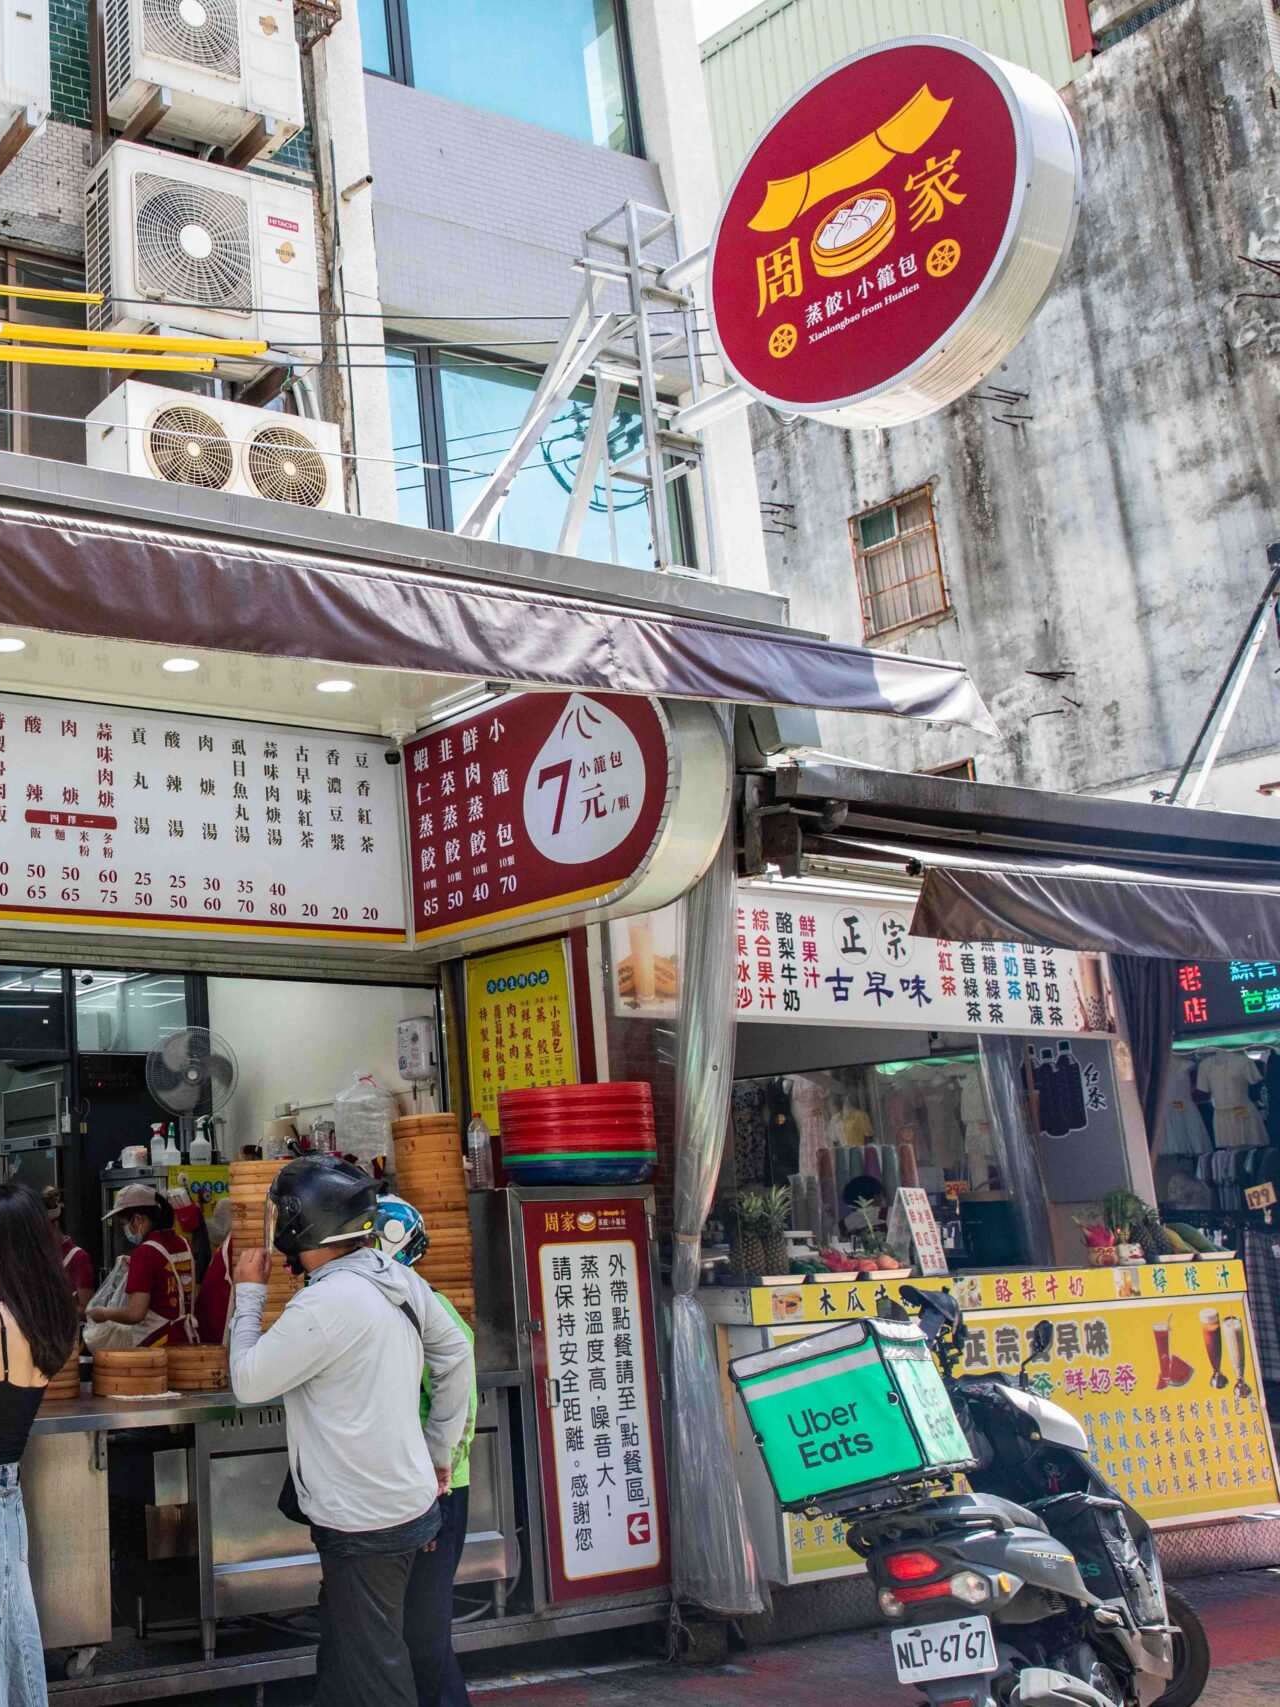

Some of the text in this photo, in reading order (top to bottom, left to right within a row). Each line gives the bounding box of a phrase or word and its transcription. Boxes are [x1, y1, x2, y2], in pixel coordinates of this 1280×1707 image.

[808, 282, 920, 345] Xiaolongbao from Hualien
[24, 715, 43, 802] 酸辣
[578, 751, 623, 780] 小籠包
[131, 727, 150, 835] 貢丸湯
[164, 731, 184, 838] 酸辣湯
[231, 738, 250, 844] 虱目魚丸湯
[462, 725, 486, 857] 鮮肉蒸餃
[488, 718, 514, 848] 小籠包
[295, 745, 314, 849] 古早味紅茶
[325, 749, 345, 851] 香濃豆漿
[354, 752, 374, 853] 豆香紅茶
[413, 747, 436, 872] 蝦仁蒸餃
[438, 738, 461, 865] 韭菜蒸餃
[537, 759, 572, 836] 7
[30, 827, 41, 839] 飯
[78, 831, 90, 857] 米粉
[103, 832, 114, 859] 冬粉
[27, 864, 46, 878] 50
[61, 867, 80, 881] 50
[99, 870, 117, 884] 60
[134, 872, 151, 886] 25
[169, 875, 186, 889] 25
[27, 886, 46, 899] 65
[61, 888, 80, 902] 65
[100, 890, 118, 904] 75
[203, 878, 220, 891] 30
[237, 880, 253, 894] 35
[269, 883, 286, 896] 40
[472, 882, 489, 902] 40
[499, 875, 517, 894] 70
[134, 892, 152, 906] 50
[170, 895, 187, 909] 50
[204, 897, 221, 911] 60
[238, 899, 254, 913] 70
[270, 903, 287, 916] 80
[302, 903, 318, 917] 20
[423, 897, 439, 916] 85
[447, 890, 463, 910] 50
[332, 906, 348, 920] 20
[362, 907, 378, 921] 20
[839, 913, 910, 961] 正宗
[752, 909, 776, 1010] 綜合果汁
[775, 911, 800, 1012] 酪梨牛奶
[799, 915, 821, 989] 鮮果汁
[824, 967, 933, 1008] 古早味
[1083, 1063, 1108, 1112] 紅茶
[544, 1211, 575, 1232] 周家
[994, 1274, 1086, 1303] 酪梨牛奶
[1152, 1264, 1231, 1293] 檸檬汁
[787, 1401, 858, 1438] Uber
[798, 1433, 874, 1469] Eats
